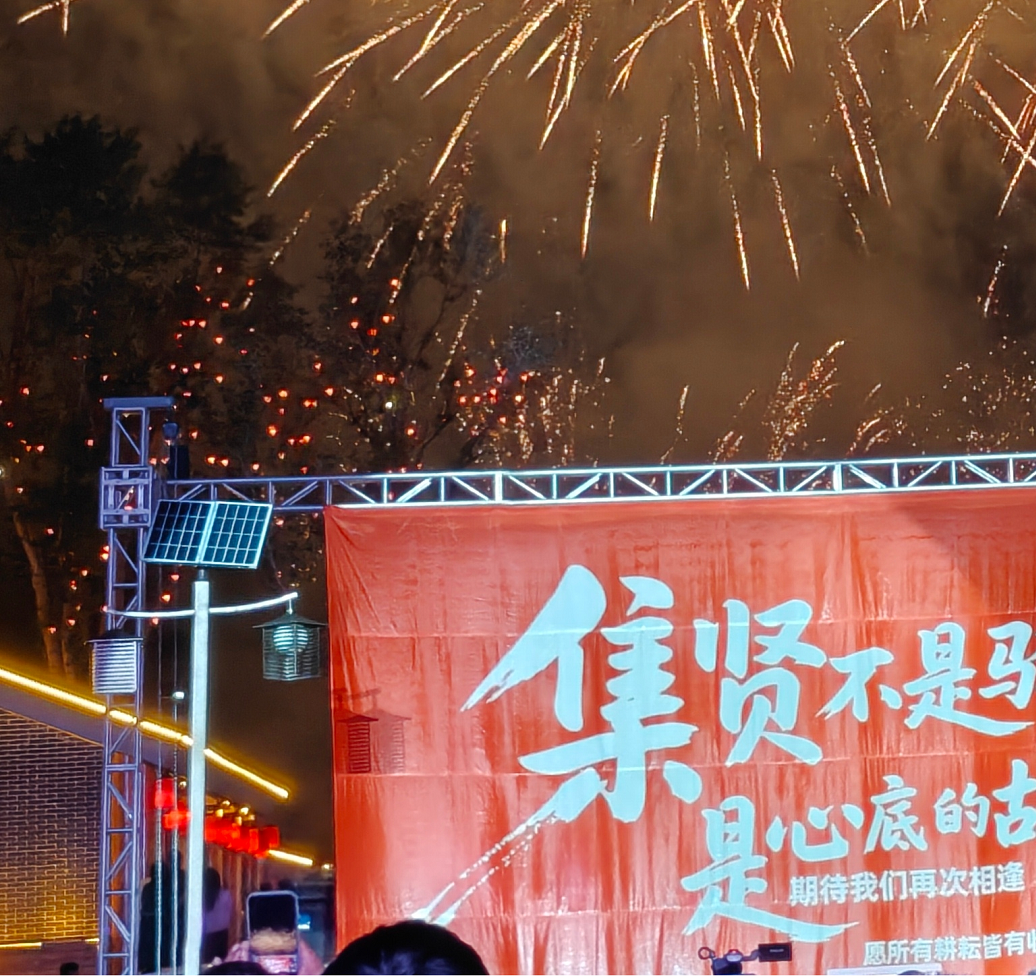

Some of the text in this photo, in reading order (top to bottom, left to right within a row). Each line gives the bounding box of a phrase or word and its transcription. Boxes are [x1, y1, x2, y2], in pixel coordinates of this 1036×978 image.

[788, 861, 1026, 907] 期待我们再次相逢
